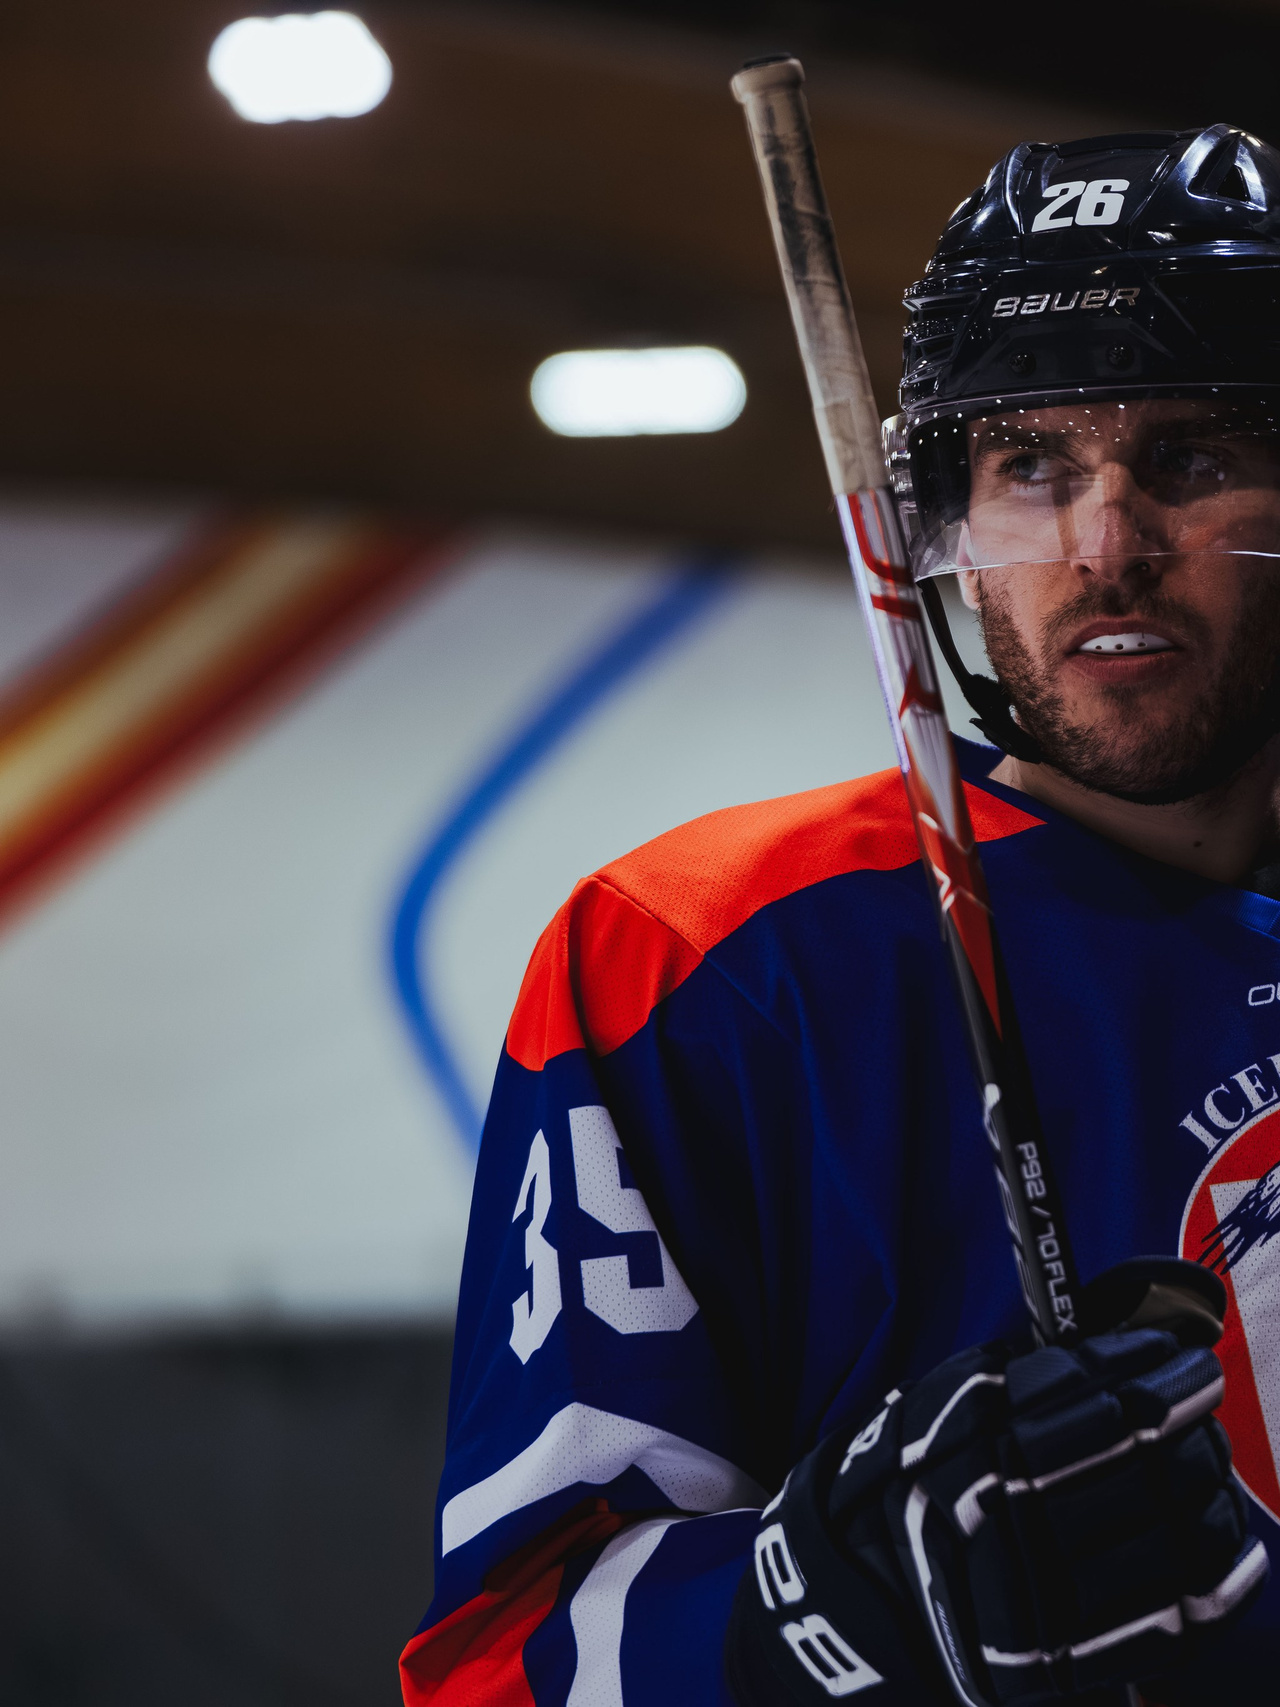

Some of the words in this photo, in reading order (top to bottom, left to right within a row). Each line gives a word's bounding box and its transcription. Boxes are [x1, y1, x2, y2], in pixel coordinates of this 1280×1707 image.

[1031, 178, 1130, 233] 26
[991, 287, 1141, 318] BAUER
[1014, 1140, 1047, 1201] P92
[508, 1104, 701, 1367] 35
